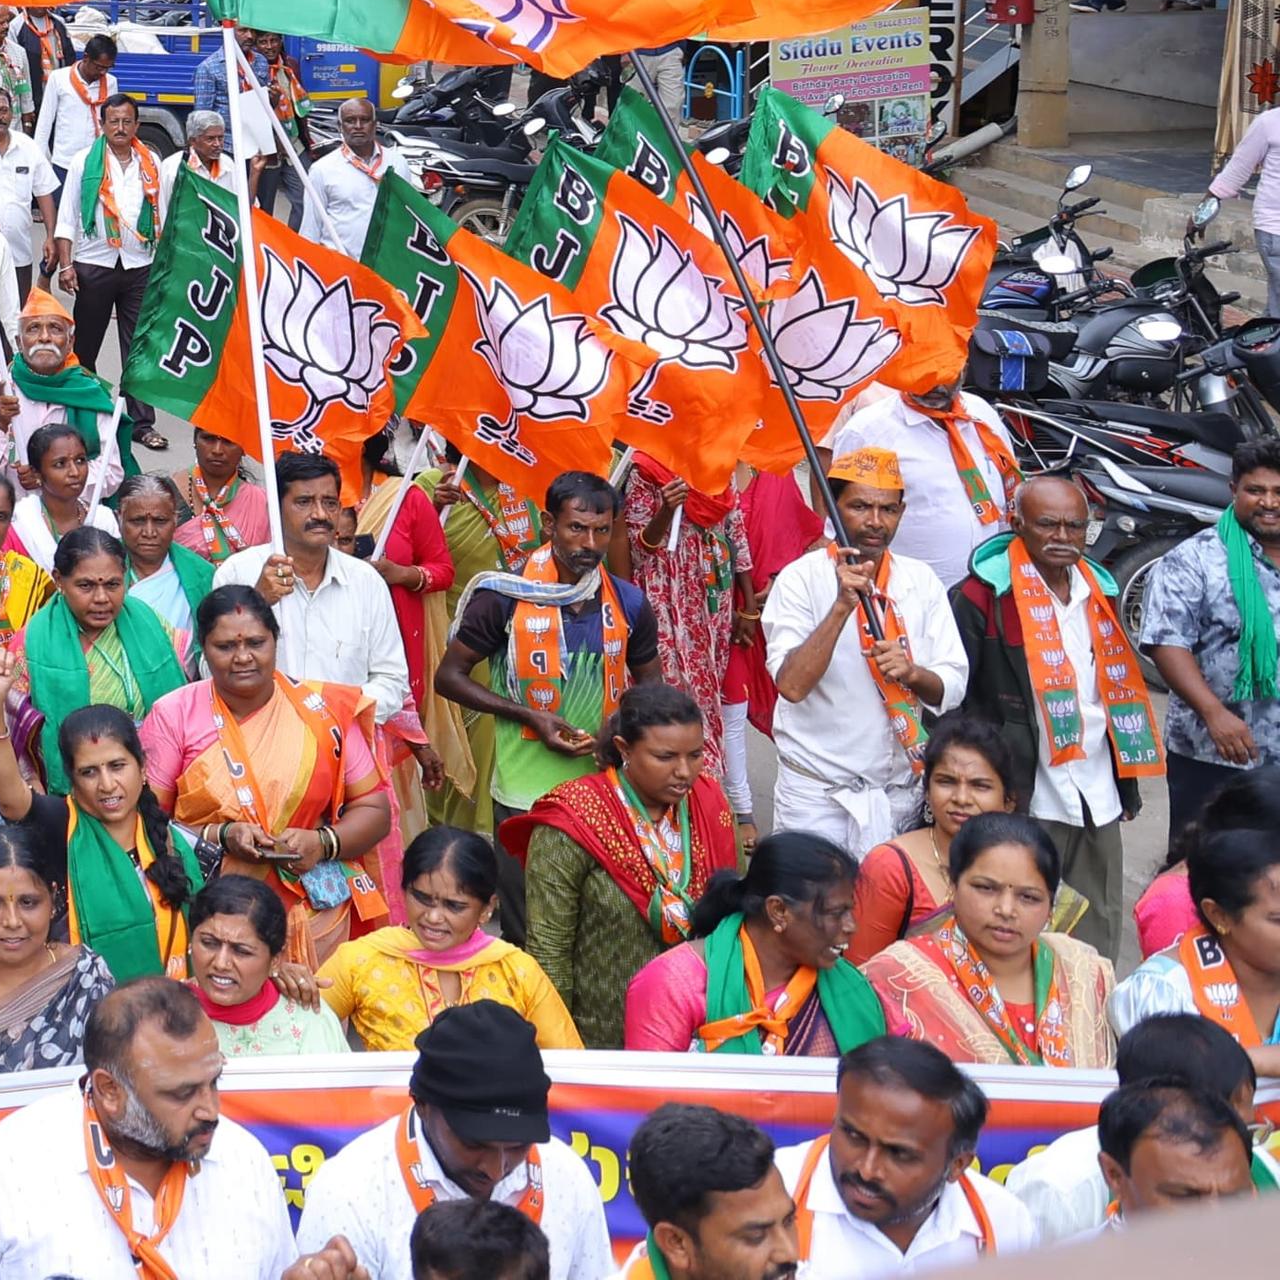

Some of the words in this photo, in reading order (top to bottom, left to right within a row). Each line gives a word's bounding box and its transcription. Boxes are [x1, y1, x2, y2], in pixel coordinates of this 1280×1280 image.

[778, 40, 842, 62] Siddu
[851, 31, 923, 55] Events
[801, 61, 839, 75] Flower
[843, 55, 904, 69] Decoration
[792, 78, 831, 91] Birthday
[833, 74, 858, 87] Party
[860, 71, 910, 84] Decoration
[852, 87, 869, 96] For
[870, 86, 889, 96] Sale
[901, 82, 923, 91] Rent
[1120, 749, 1160, 764] B.J.P
